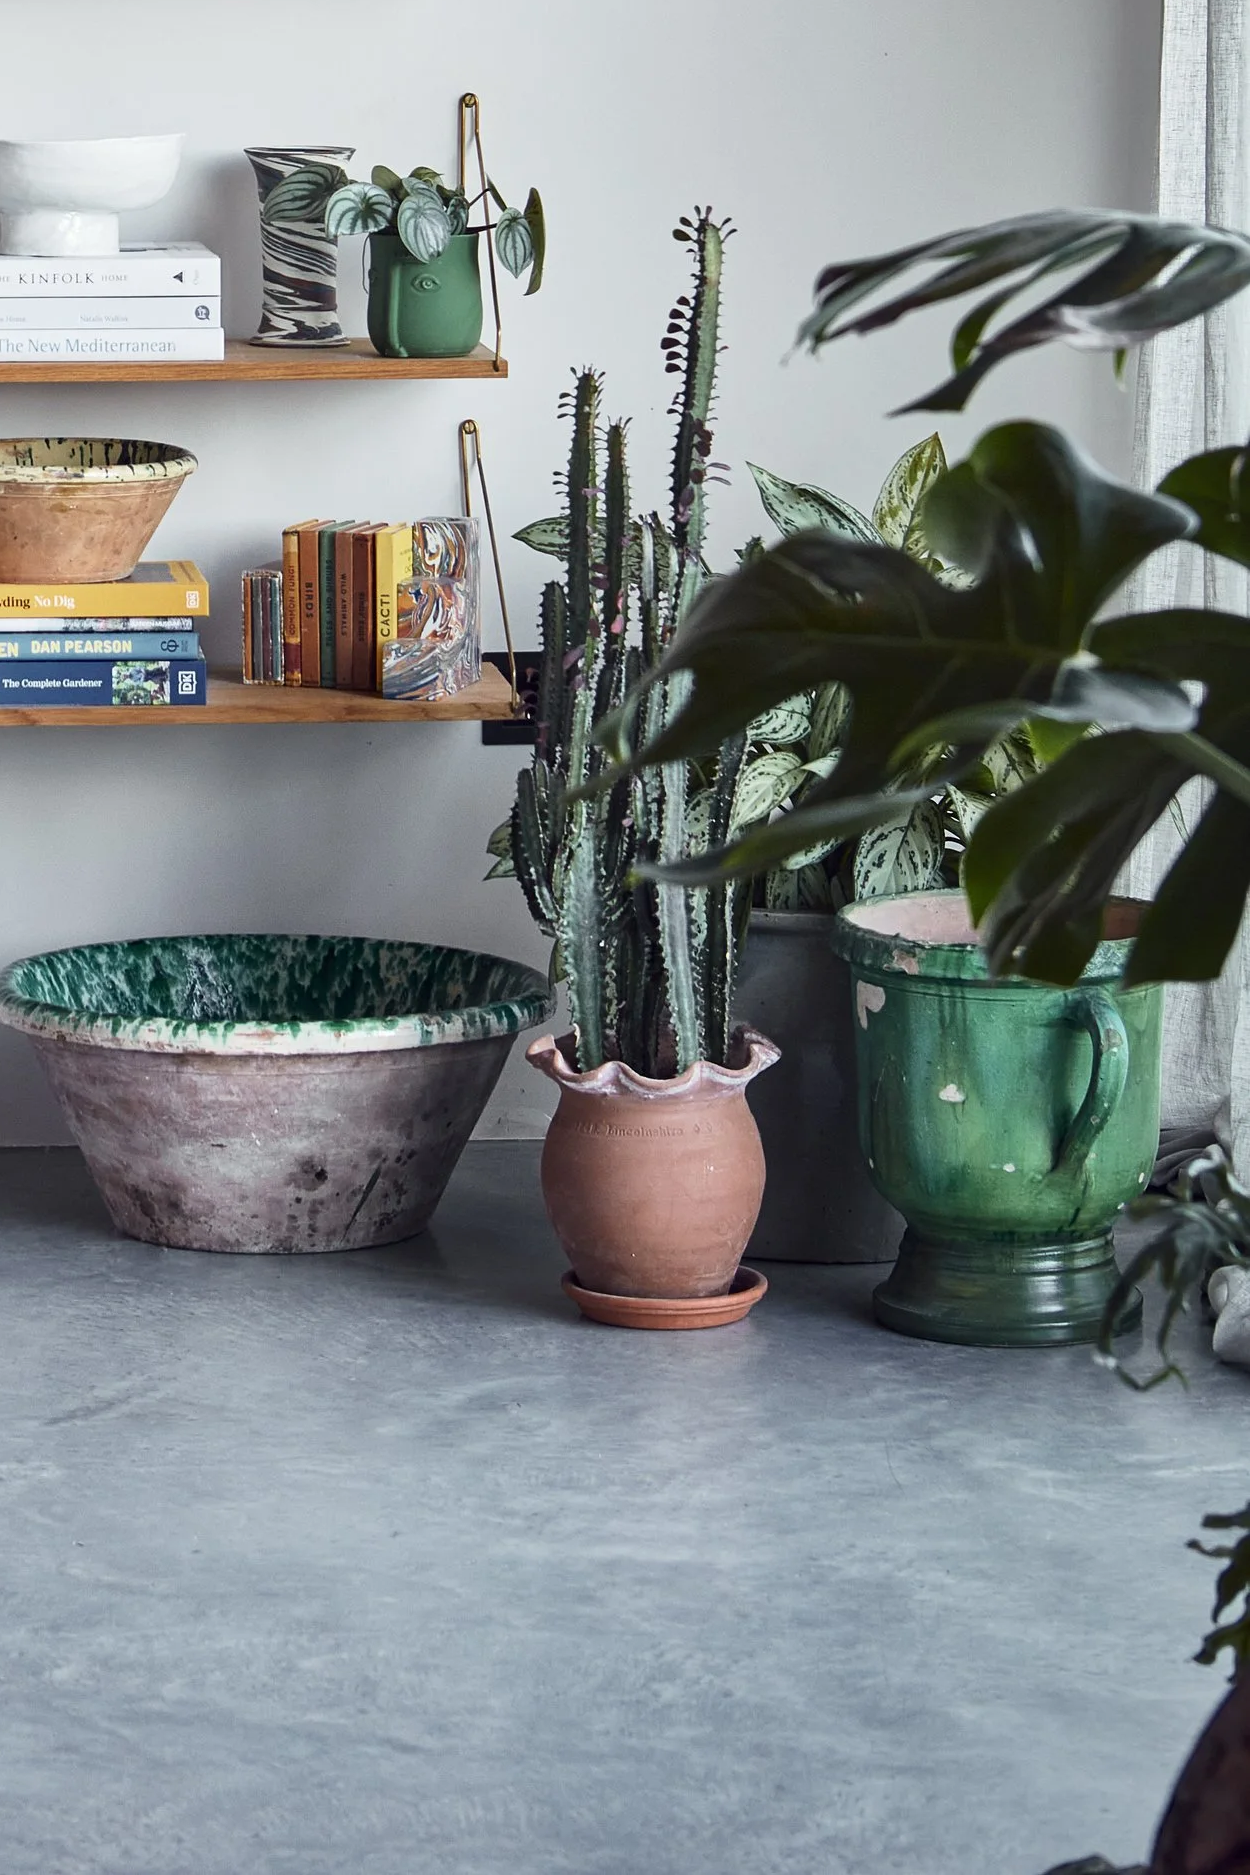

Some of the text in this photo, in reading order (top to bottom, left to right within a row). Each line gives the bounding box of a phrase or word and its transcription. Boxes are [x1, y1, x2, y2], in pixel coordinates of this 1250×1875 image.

[18, 273, 95, 285] KINFOLK
[101, 274, 128, 282] HOME
[28, 338, 62, 353] New
[65, 337, 176, 353] Mediterranean
[34, 595, 51, 607] No
[53, 595, 76, 610] Dig
[288, 564, 296, 636] COMMON FUNGI
[305, 581, 314, 619] BIRDS
[380, 593, 391, 637] CACTI
[31, 640, 132, 654] DAN PEARSON
[2, 678, 20, 688] The
[21, 678, 61, 689] Complete
[62, 678, 103, 688] Gardener
